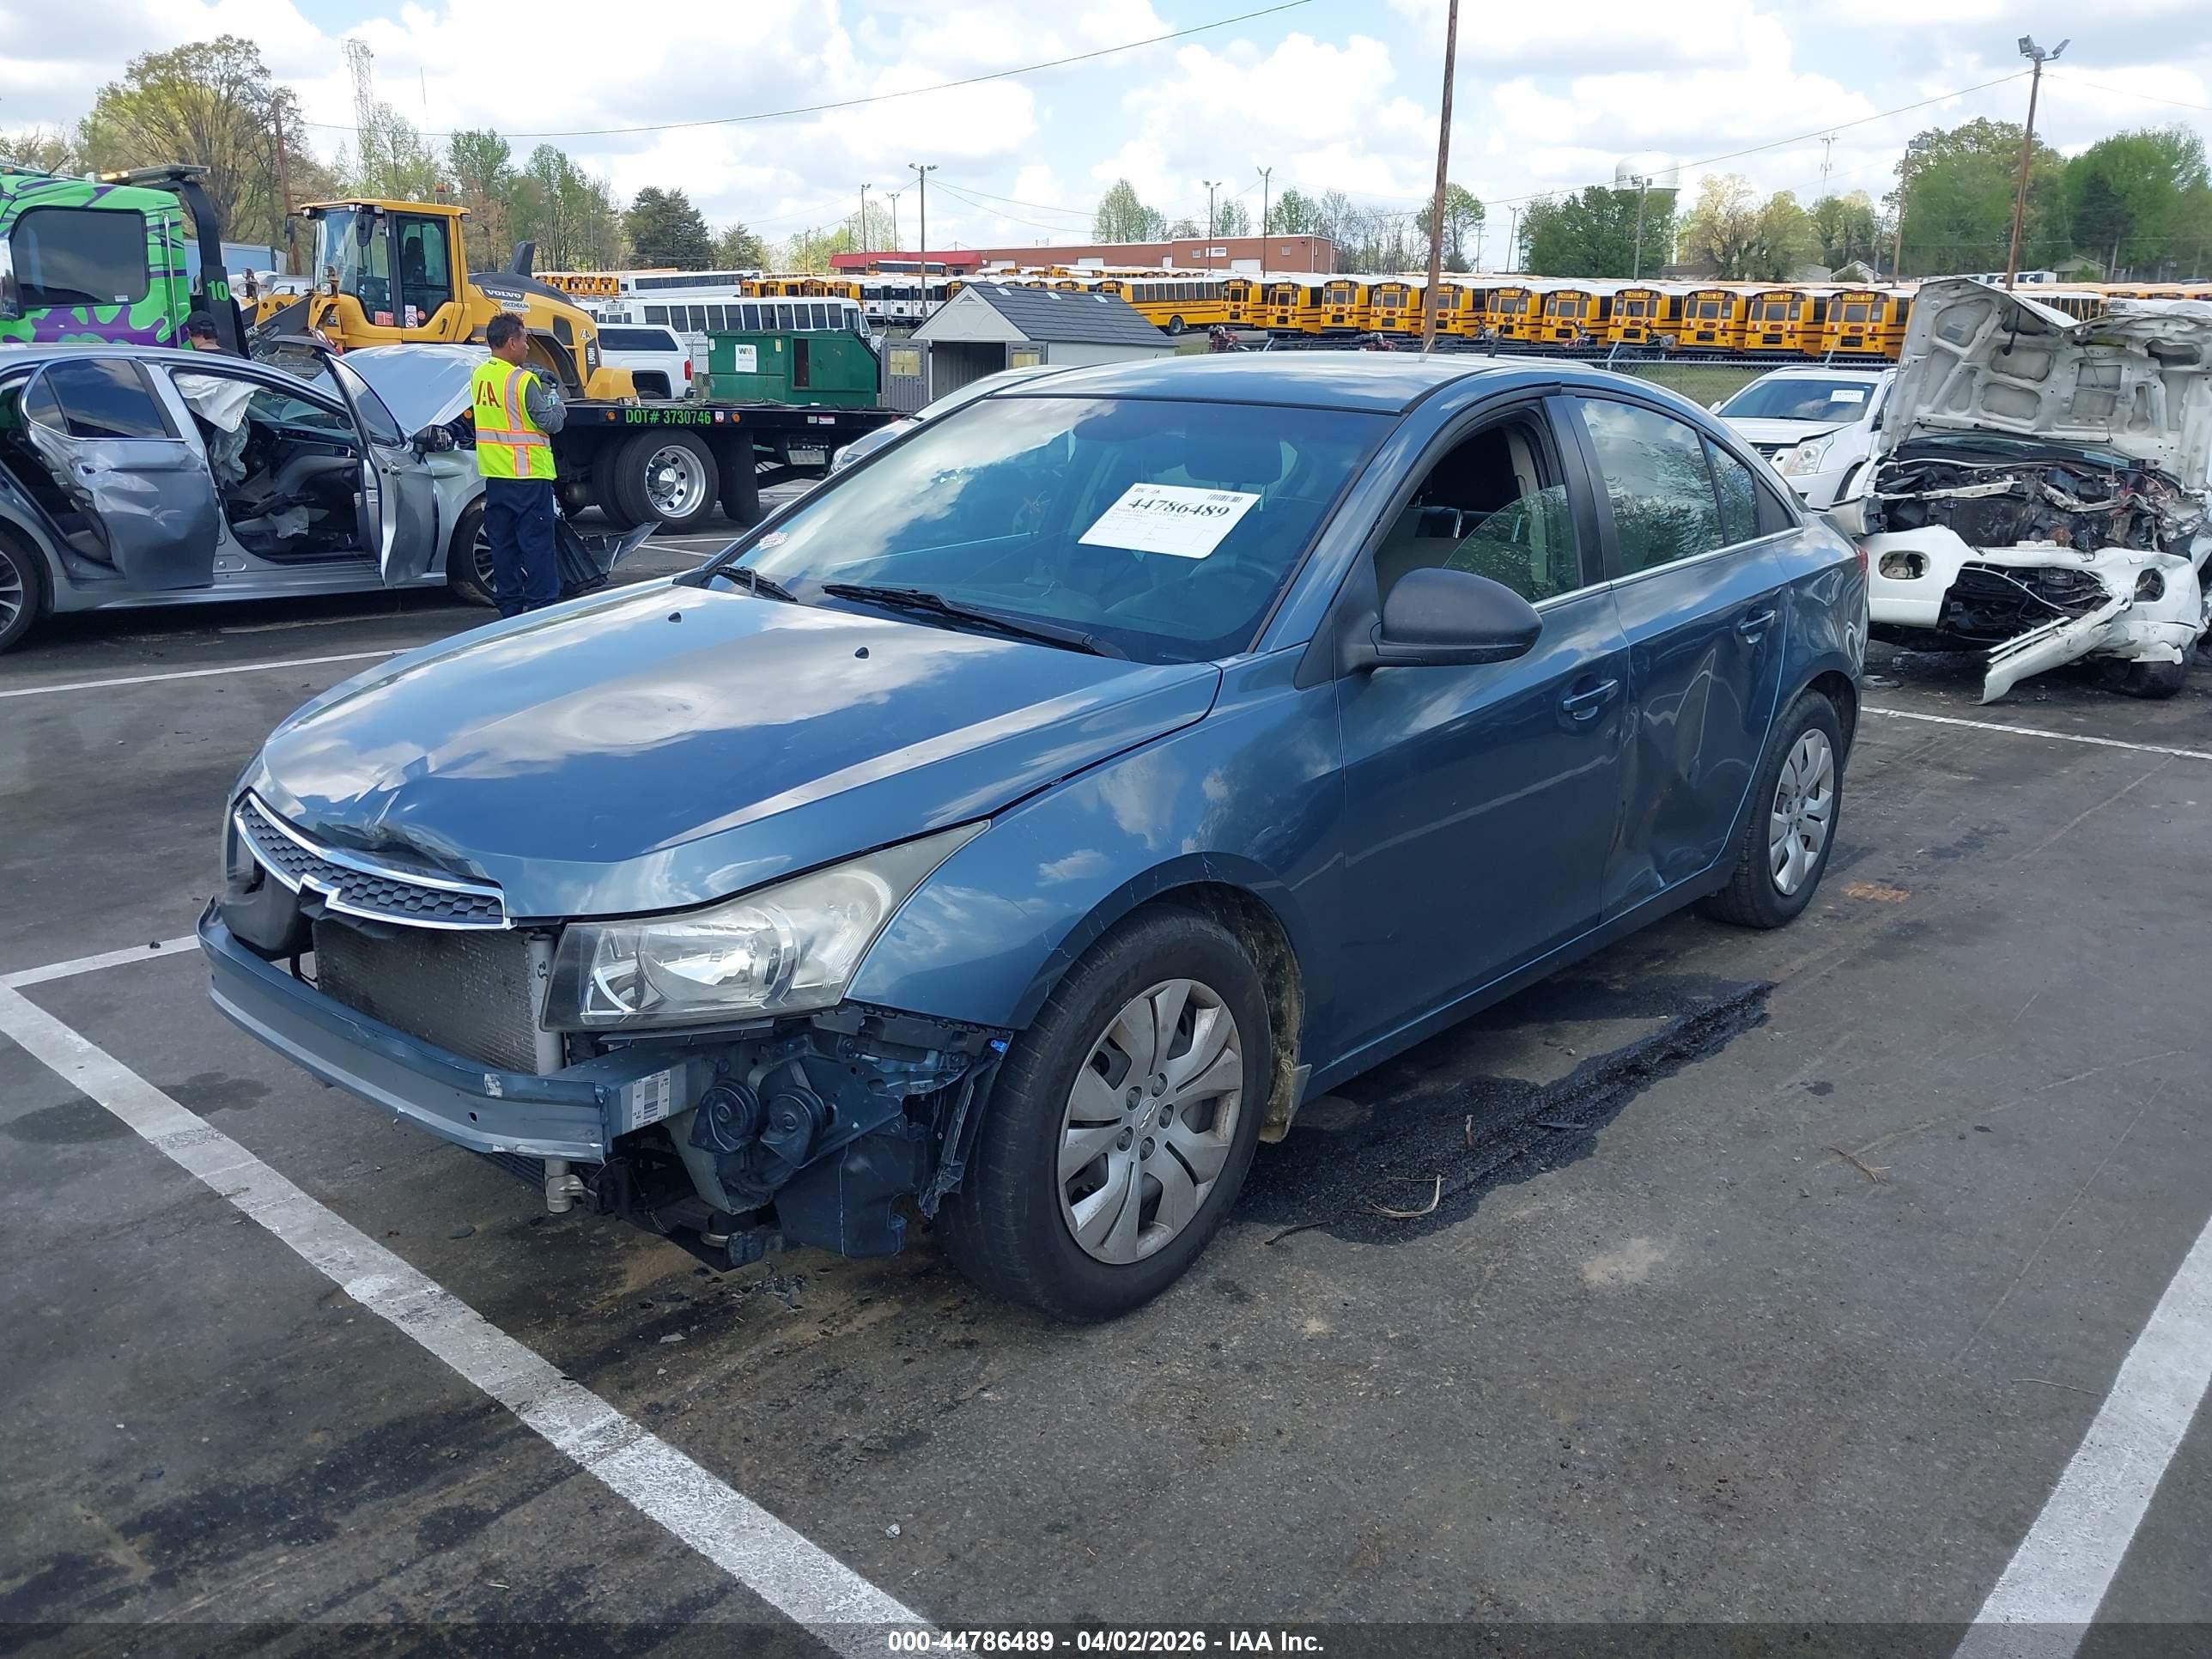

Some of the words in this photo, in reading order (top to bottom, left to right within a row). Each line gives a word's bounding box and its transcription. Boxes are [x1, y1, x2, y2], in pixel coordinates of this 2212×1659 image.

[207, 280, 229, 301] 10
[485, 289, 521, 299] VOLVO
[625, 410, 659, 423] DOT#
[663, 410, 711, 425] 3730746
[1127, 497, 1231, 519] 44786489
